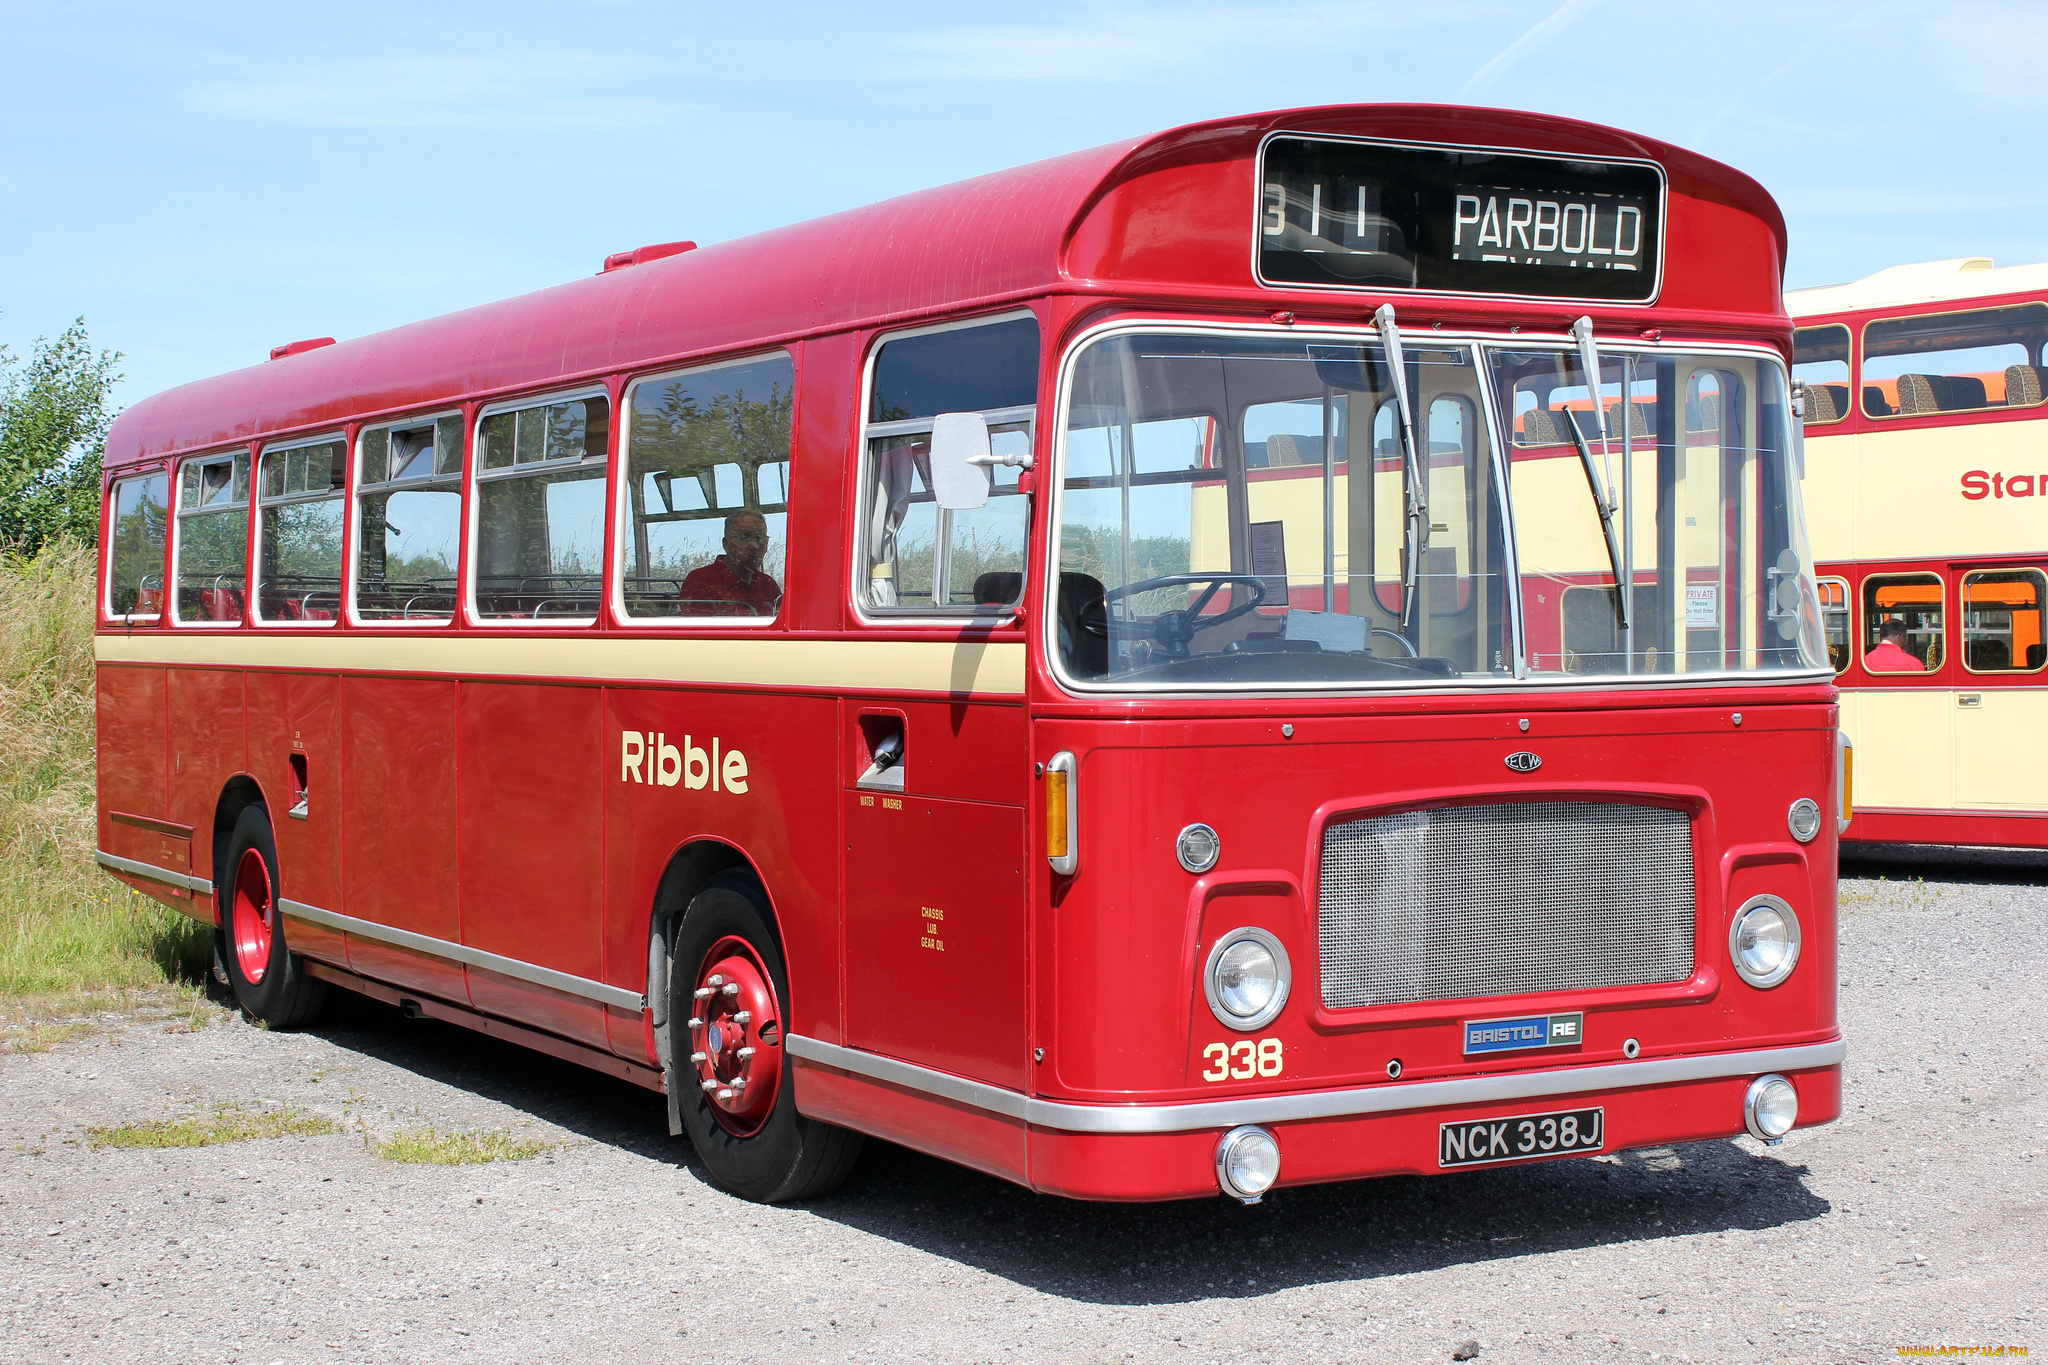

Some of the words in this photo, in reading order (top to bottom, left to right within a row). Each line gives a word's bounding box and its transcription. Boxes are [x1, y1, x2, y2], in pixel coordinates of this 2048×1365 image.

[1454, 195, 1642, 256] PARBOLD
[1686, 590, 1714, 598] PRIVATE
[621, 730, 749, 794] Ribble
[1509, 753, 1540, 769] ECW
[860, 795, 874, 807] WATER
[882, 797, 903, 811] WASHER
[921, 906, 944, 921] CHASSIS
[926, 922, 939, 935] LUB.
[921, 936, 935, 949] GEAR
[936, 939, 945, 952] OIL
[1469, 1025, 1544, 1045] BRISTOL
[1552, 1022, 1577, 1037] RE
[1202, 1037, 1283, 1082] 338
[1445, 1122, 1509, 1161] NCK
[1517, 1112, 1600, 1152] 338J
